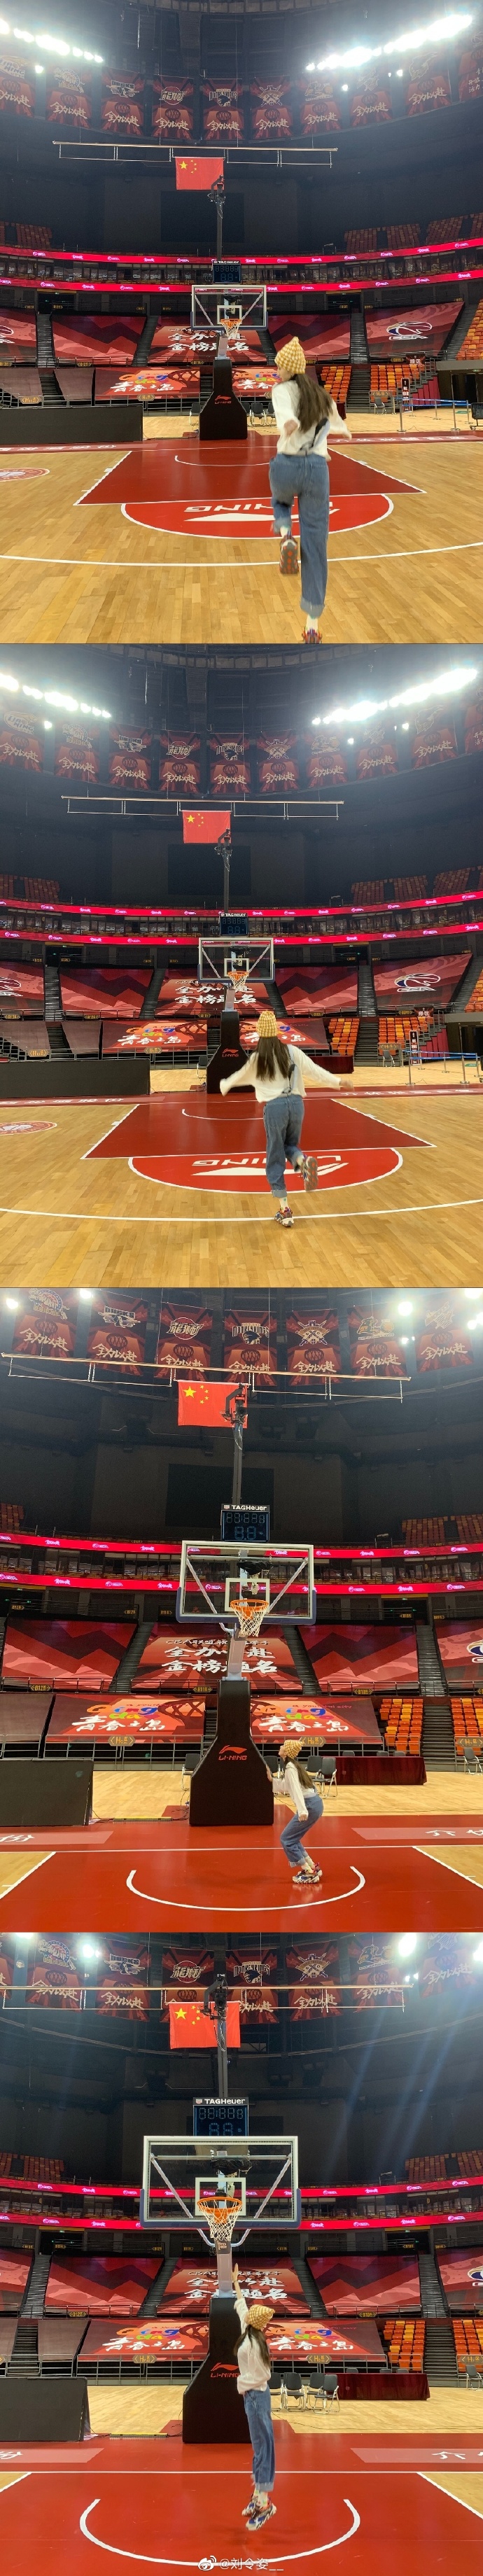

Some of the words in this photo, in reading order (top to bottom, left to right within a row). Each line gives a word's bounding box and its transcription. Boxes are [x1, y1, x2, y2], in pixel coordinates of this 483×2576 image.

[0, 90, 31, 107] 力以赴
[409, 88, 447, 105] 全力以赴
[50, 102, 88, 119] 全力以赴
[353, 102, 388, 116] 全力以赴
[105, 111, 140, 127] 全力以赴
[155, 118, 189, 131] 全力以赴
[207, 120, 241, 131] 全力以赴
[256, 118, 289, 130] 全力以赴
[304, 112, 338, 125] 全力以赴
[168, 332, 247, 341] 全力赴
[111, 381, 174, 392] 青春之岛
[0, 742, 39, 762] 全力以赴
[414, 741, 454, 758] 全力以赴
[58, 756, 95, 774] 全力以赴
[359, 755, 395, 769] 全力以赴
[113, 765, 147, 780] 全力以赴
[163, 771, 196, 784] 全力以赴
[262, 772, 296, 784] 全力以赴
[312, 765, 344, 778] 全力以赴
[214, 773, 247, 785] 全力以赴
[175, 986, 255, 994] 全力赴
[118, 1035, 181, 1046] 青春之岛
[245, 1032, 306, 1042] 青之岛
[20, 1328, 69, 1352] 全力以赴
[92, 1343, 137, 1362] 全力以赴
[421, 1342, 468, 1360] 全力以赴
[293, 1361, 337, 1373] 全力以赴
[356, 1354, 401, 1369] 全力以赴
[164, 1646, 276, 1658] 全力赴
[71, 1715, 165, 1732] 青春之岛
[259, 1716, 349, 1732] 青春之岛
[423, 1963, 473, 1984] 全力以赴
[101, 1991, 144, 2010] 全力以赴
[239, 2001, 274, 2013] 力以赴
[294, 1994, 337, 2009] 全力以赴
[186, 2276, 285, 2287] 全以赴
[184, 2288, 287, 2300] 金题名
[102, 2337, 185, 2351] 青春之岛
[270, 2336, 354, 2351] 青春之岛
